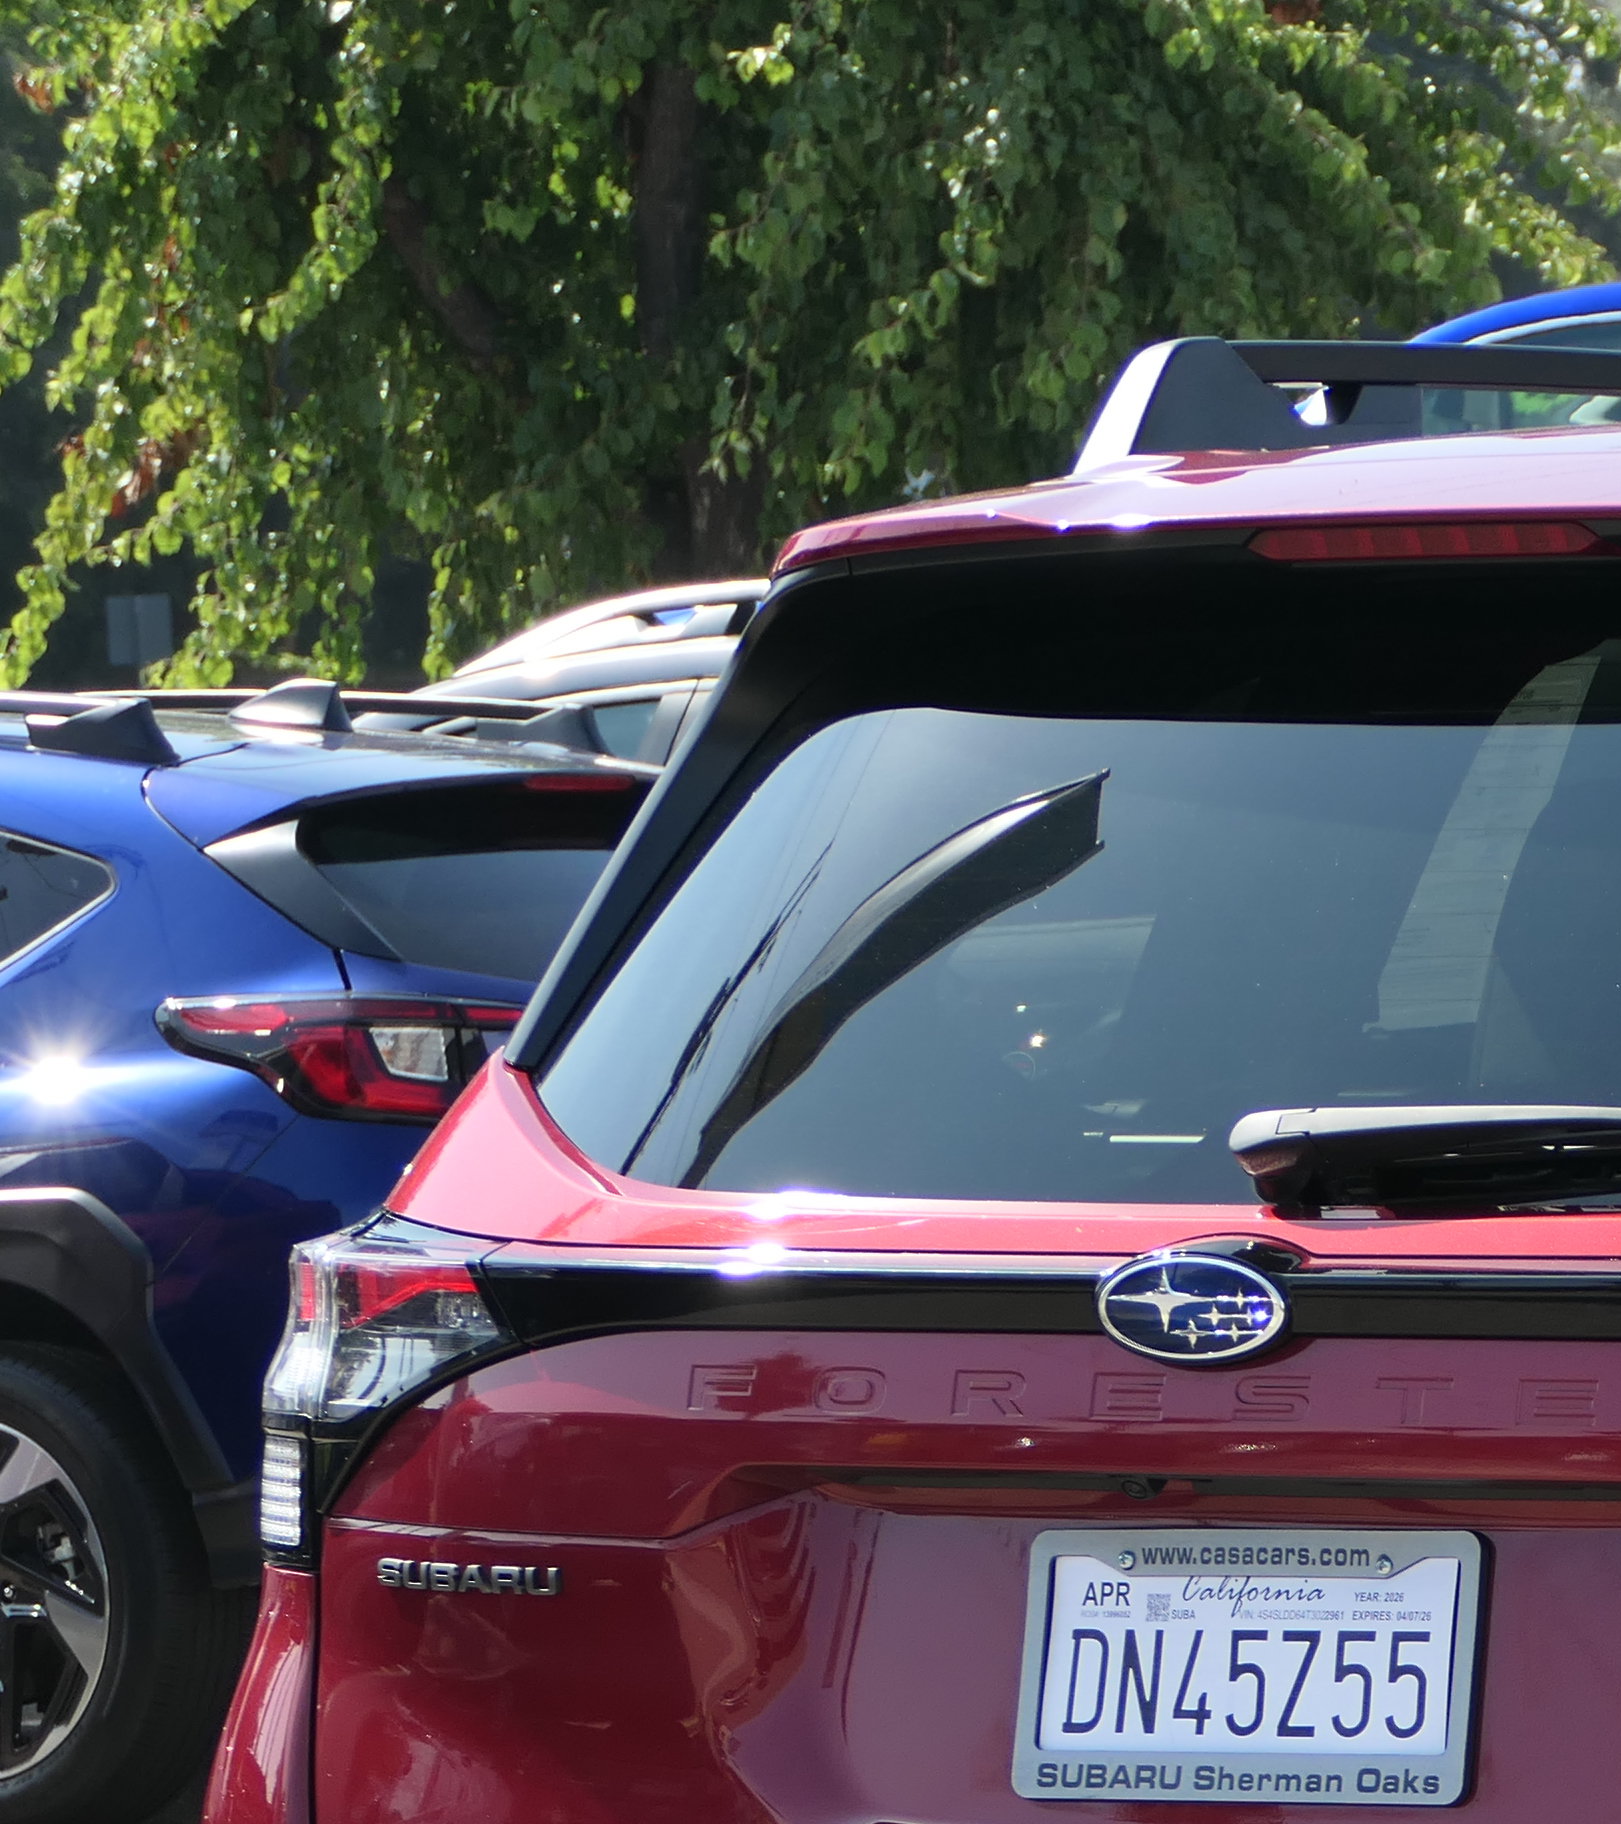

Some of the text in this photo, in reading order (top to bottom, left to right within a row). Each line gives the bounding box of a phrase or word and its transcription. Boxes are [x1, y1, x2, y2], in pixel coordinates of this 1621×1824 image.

[1142, 1544, 1370, 1569] www.casacars.com
[376, 1557, 562, 1596] SUBARU
[1082, 1582, 1131, 1607] APR
[1183, 1576, 1325, 1618] California
[1355, 1591, 1404, 1603] YEAR: 2026
[1171, 1609, 1195, 1620] SUBA
[1352, 1610, 1432, 1621] EXPIRES: 04/07/26
[1061, 1629, 1432, 1739] DN45Z55
[1036, 1762, 1440, 1795] SUBARU Sherman Oaks
